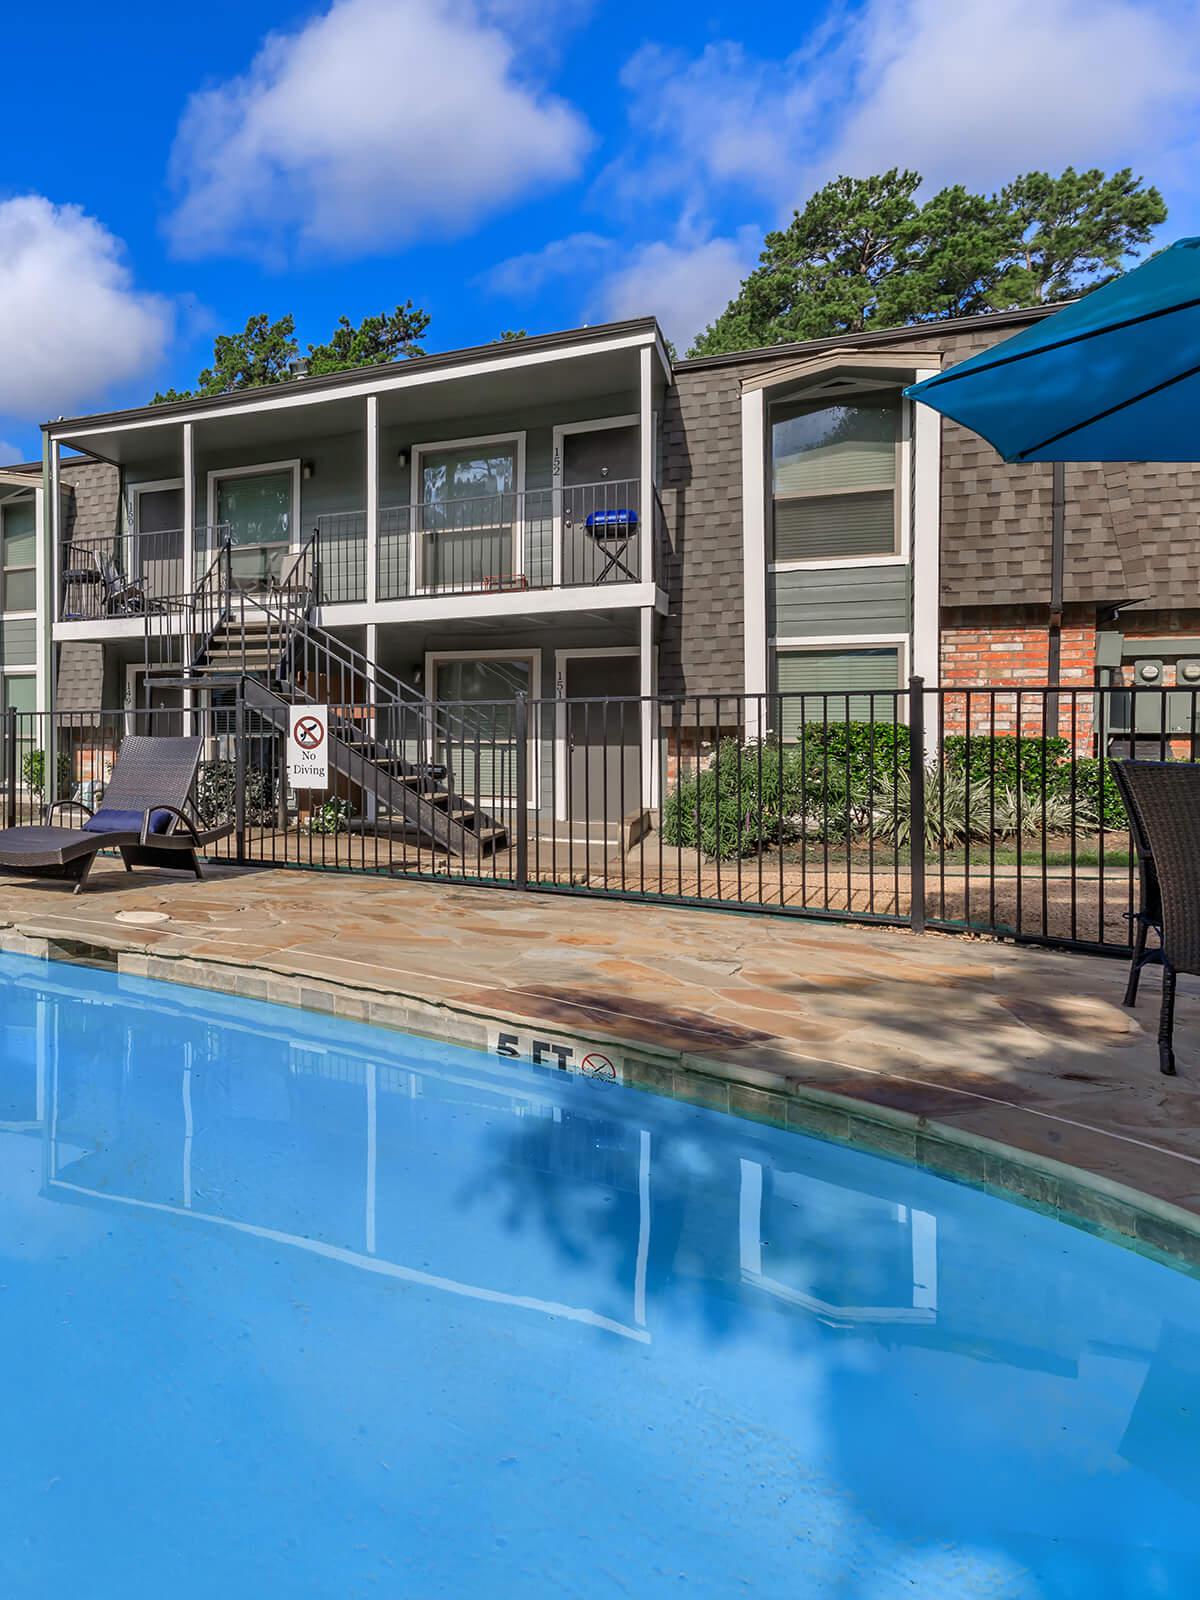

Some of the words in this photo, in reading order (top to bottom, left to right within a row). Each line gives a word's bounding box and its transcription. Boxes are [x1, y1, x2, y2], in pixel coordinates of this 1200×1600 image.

[302, 751, 317, 760] No
[294, 764, 326, 777] Diving
[496, 1032, 520, 1058] 5
[533, 1040, 574, 1071] FT
